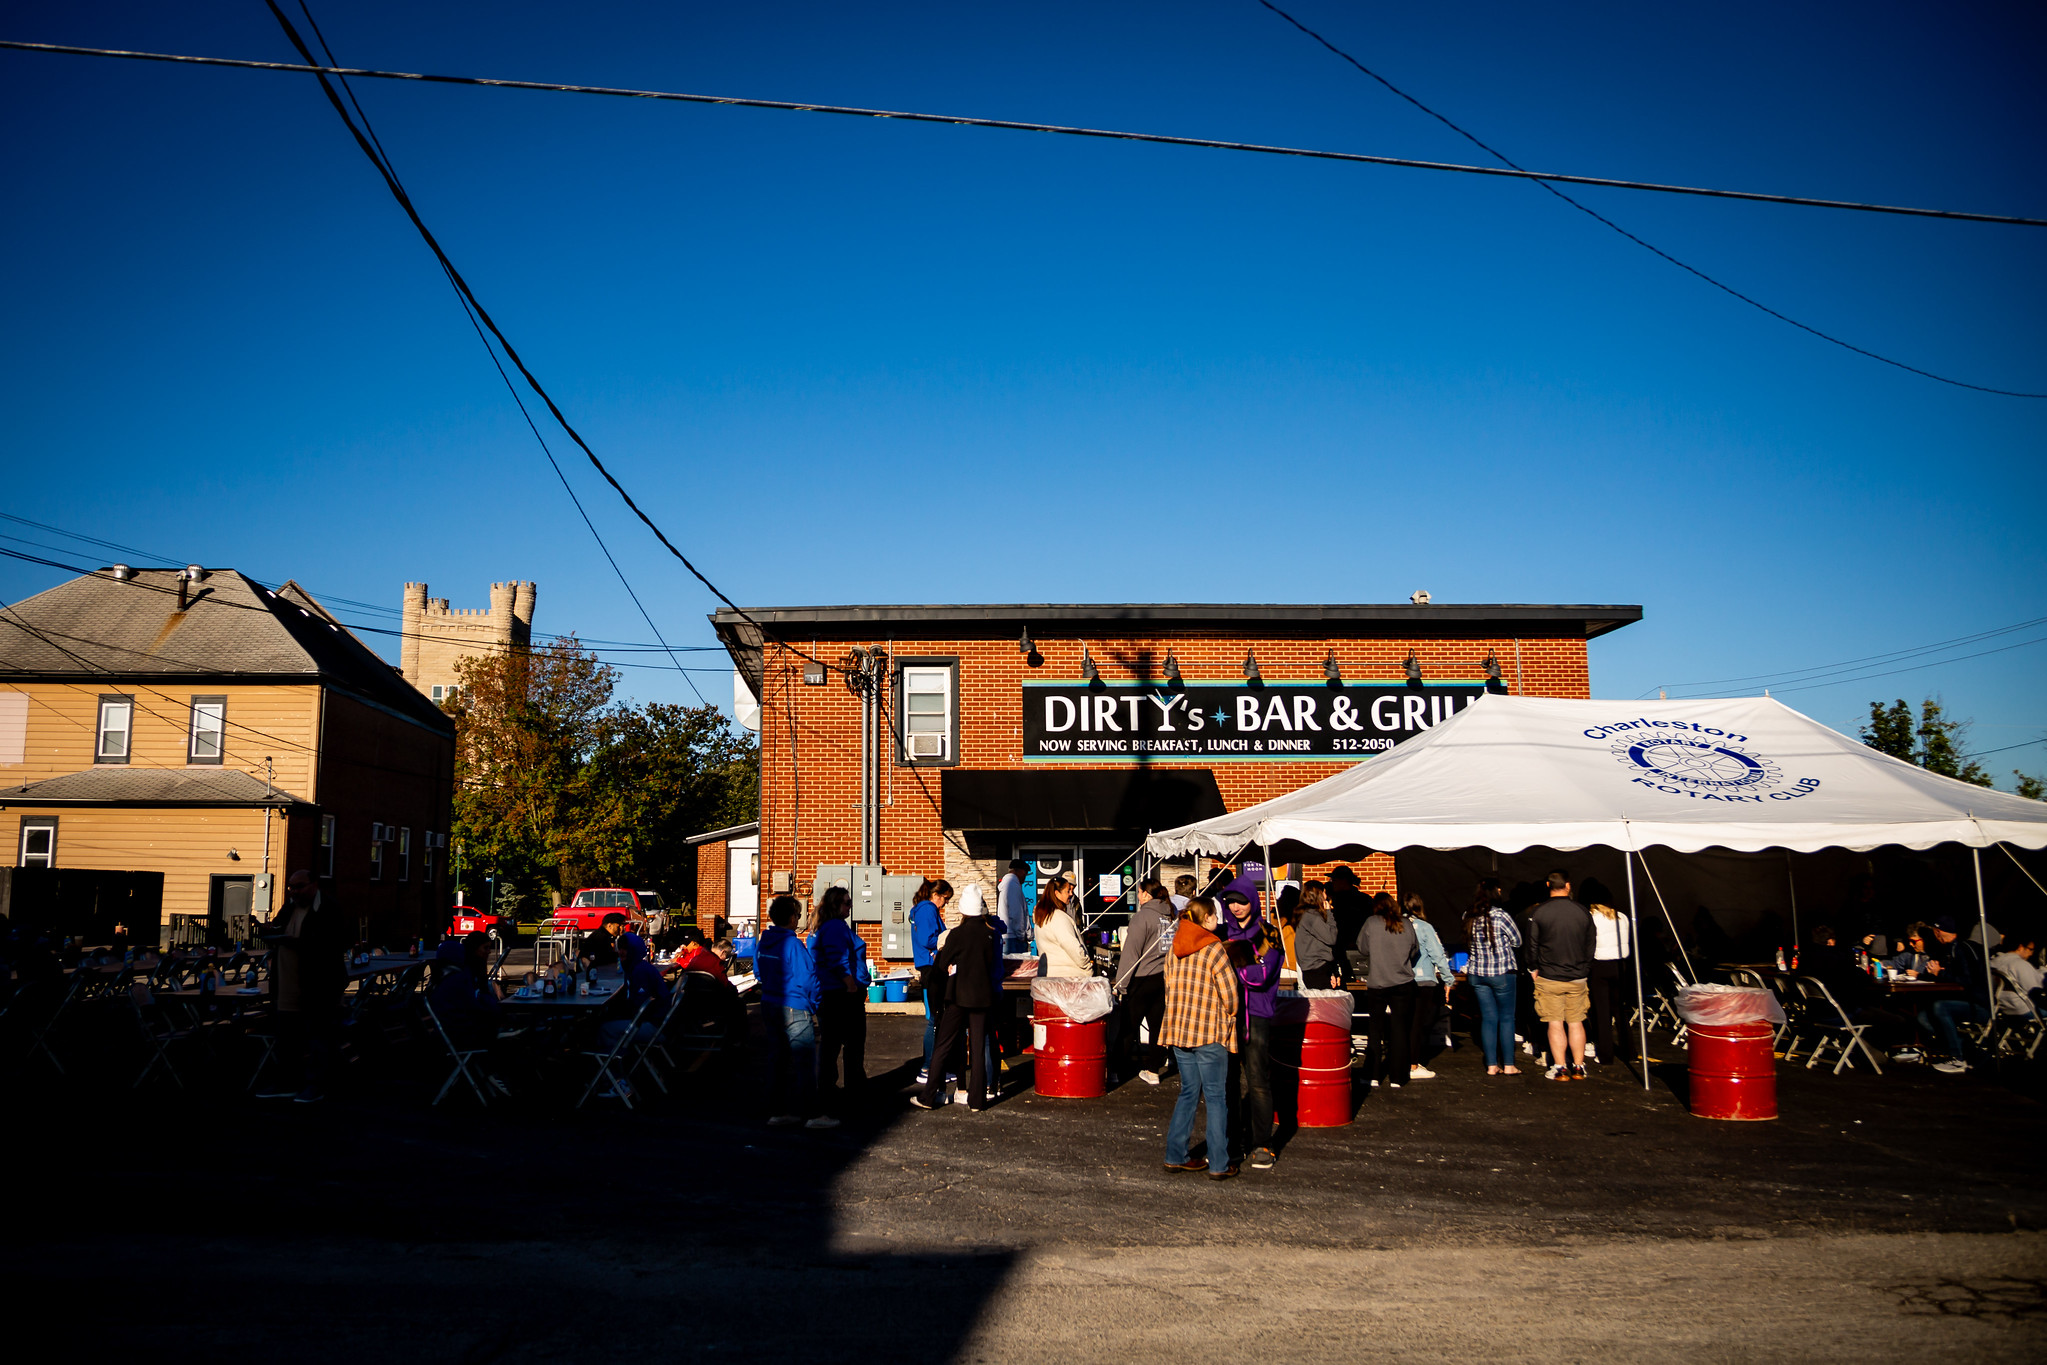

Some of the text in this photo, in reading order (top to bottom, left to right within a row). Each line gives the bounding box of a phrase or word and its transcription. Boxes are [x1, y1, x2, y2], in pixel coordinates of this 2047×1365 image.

[1045, 692, 1205, 732] DIRTY's
[1236, 695, 1323, 732] BAR
[1329, 695, 1364, 731] &
[1583, 718, 1748, 742] Charleston
[1039, 738, 1395, 753] NOW SERVING BREAKFAST, LUNCH & DINNER 512-2050
[1631, 777, 1821, 803] ROTARY CLUB
